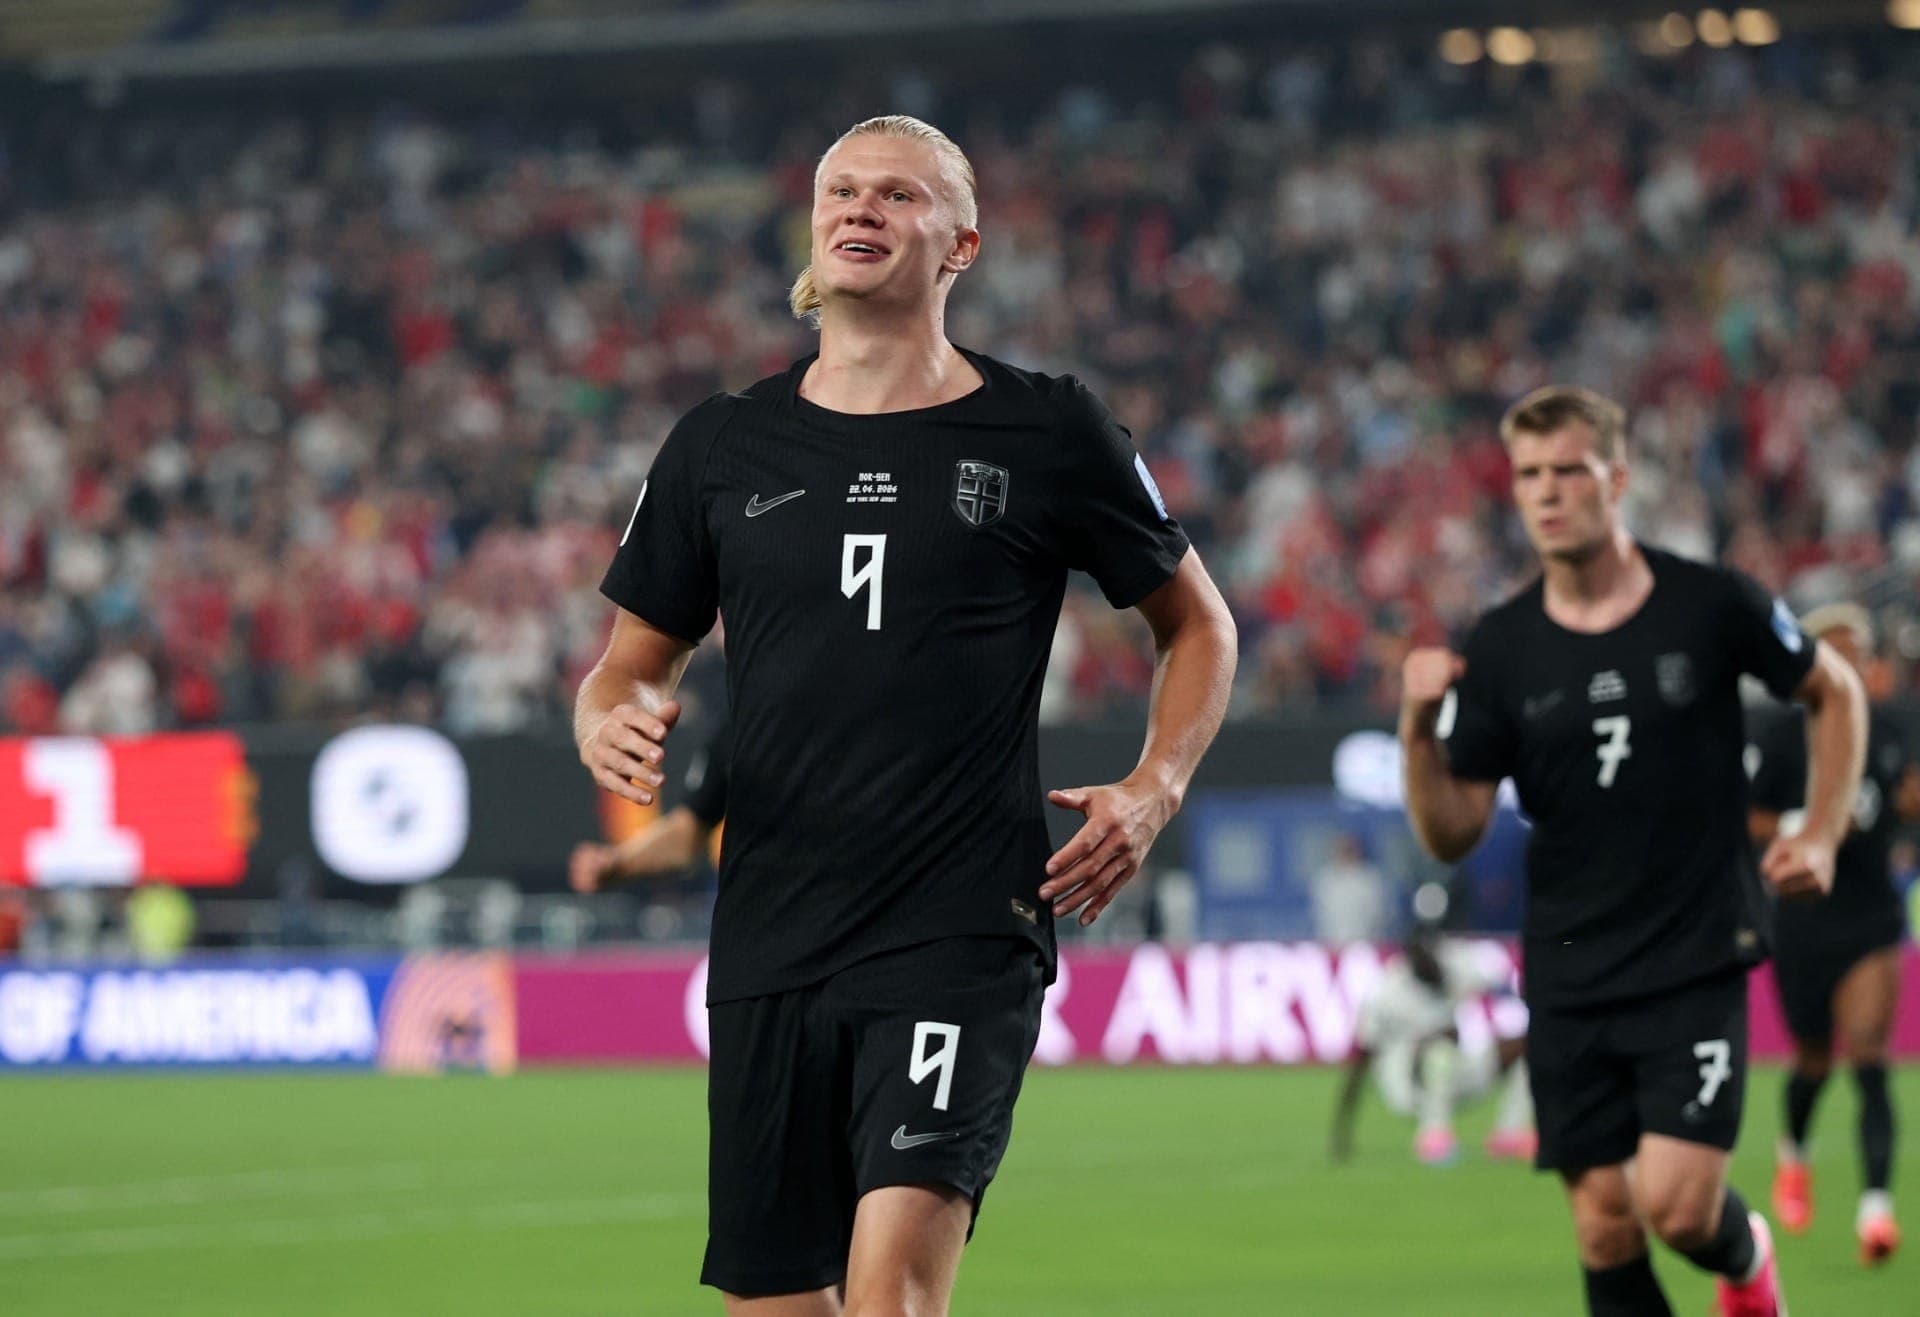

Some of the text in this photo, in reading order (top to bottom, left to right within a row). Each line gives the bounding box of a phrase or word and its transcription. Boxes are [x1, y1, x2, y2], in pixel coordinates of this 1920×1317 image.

[858, 472, 891, 482] NOR-SEN
[840, 533, 888, 631] 9
[1592, 715, 1632, 788] 7
[21, 735, 144, 887] 1
[1101, 941, 1528, 1065] AIRW
[908, 1021, 961, 1112] 9
[1693, 1038, 1732, 1107] 7
